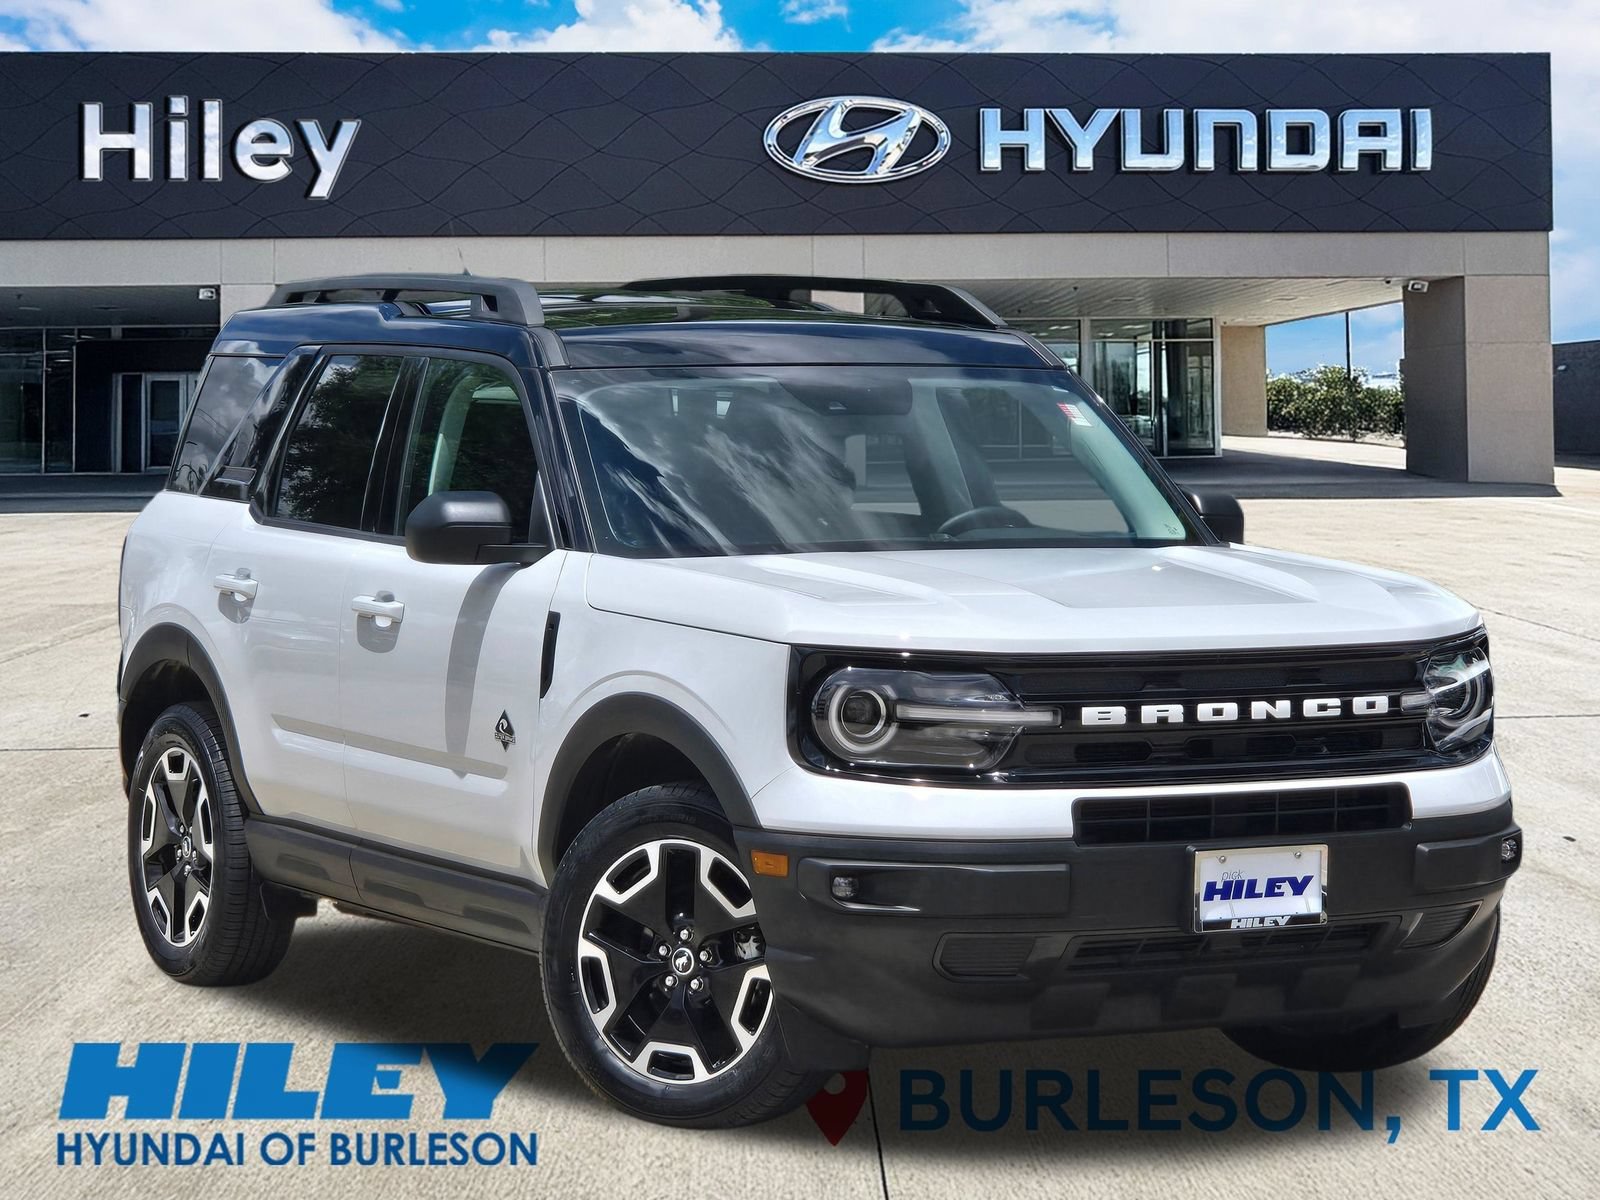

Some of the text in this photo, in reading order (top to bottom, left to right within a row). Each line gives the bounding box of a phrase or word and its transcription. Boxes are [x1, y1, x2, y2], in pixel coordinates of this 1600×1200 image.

[79, 95, 361, 199] Hiley
[980, 108, 1432, 172] HYUNDAI
[1081, 696, 1389, 725] BRONCO
[1203, 876, 1314, 902] HILEY
[1231, 915, 1291, 929] HILEY
